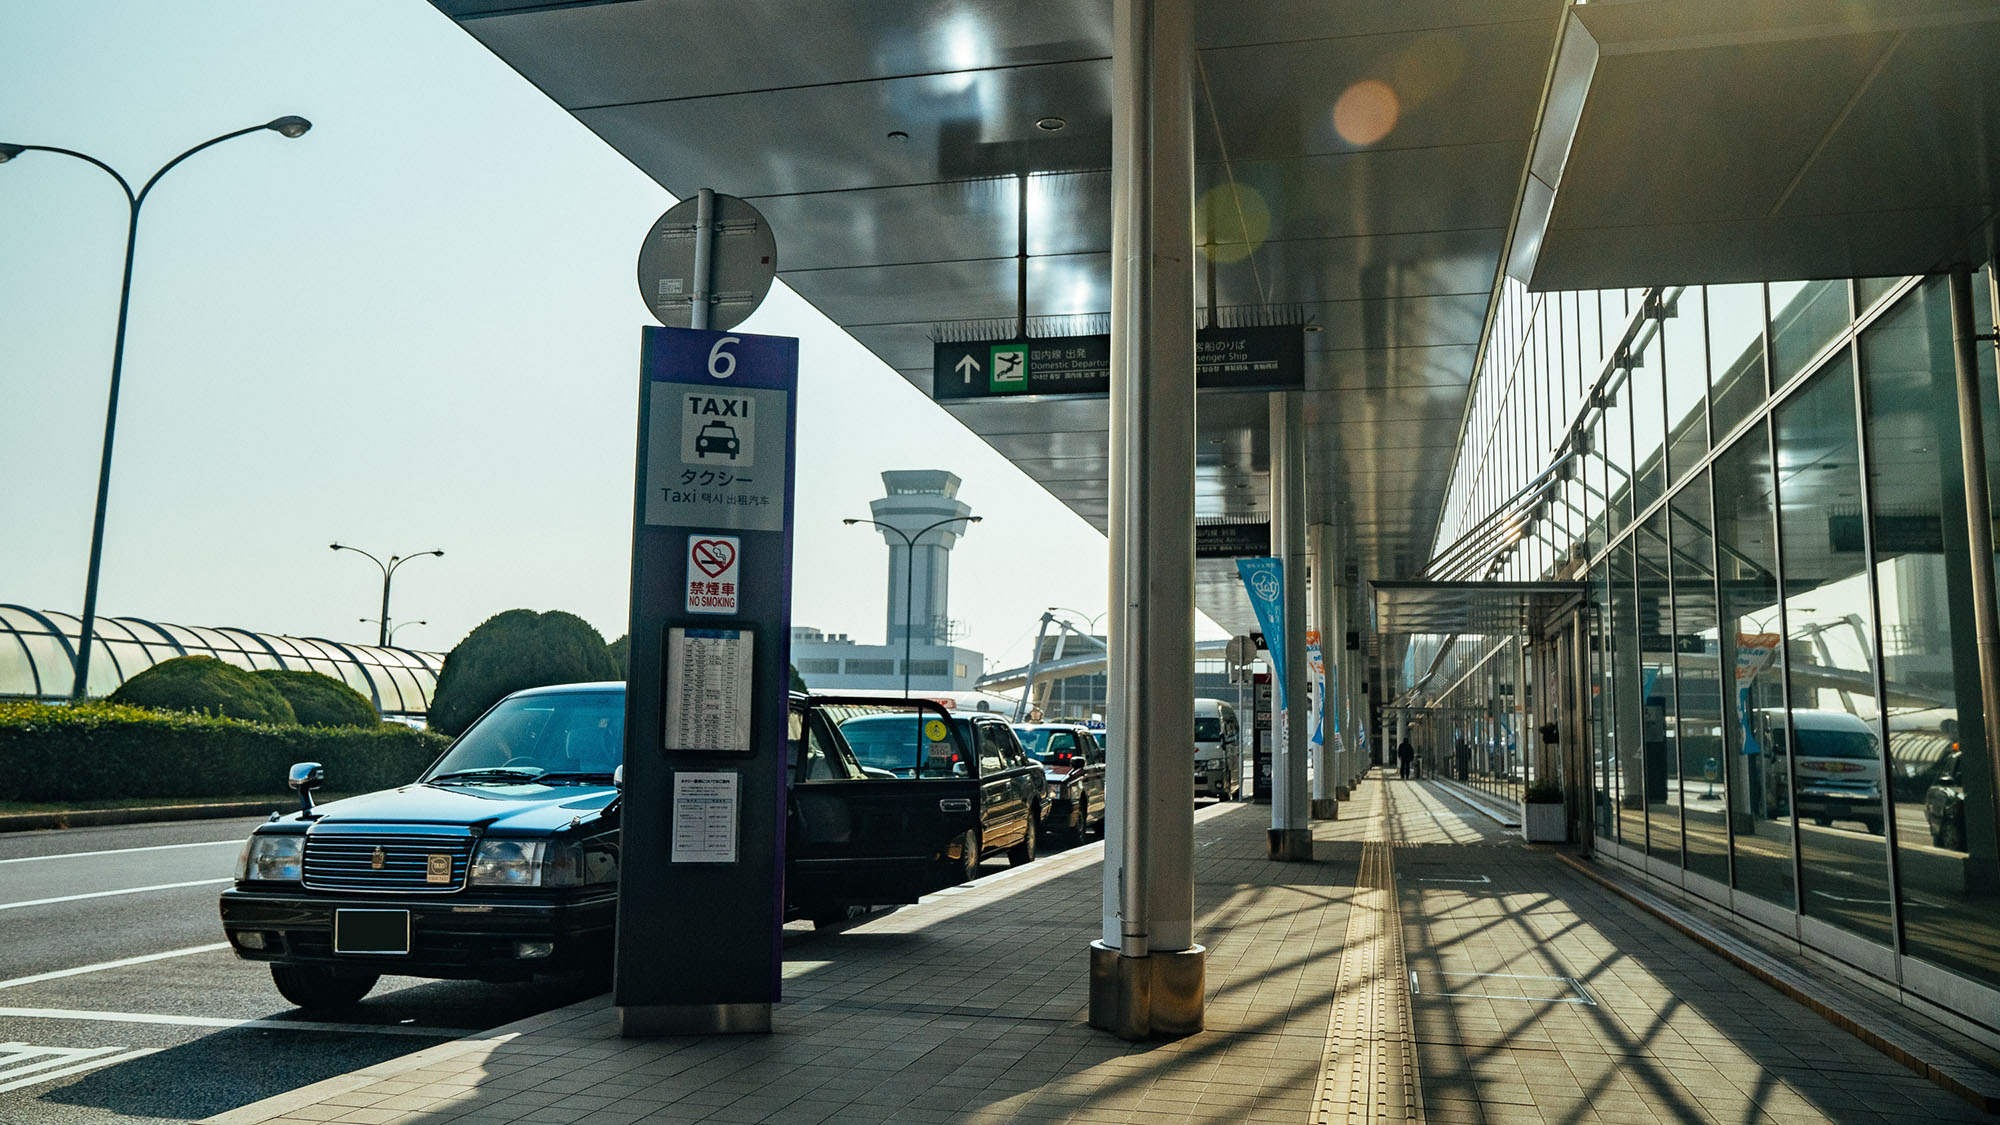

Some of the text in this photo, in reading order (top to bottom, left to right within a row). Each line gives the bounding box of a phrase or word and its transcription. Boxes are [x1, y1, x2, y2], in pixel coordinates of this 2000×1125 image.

[1196, 340, 1247, 352] 客船のりば
[708, 337, 740, 379] 6
[1065, 348, 1087, 359] 出発
[1196, 352, 1248, 363] senger Ship
[1031, 359, 1110, 370] Domestic Departur
[689, 397, 748, 418] TAXI
[681, 469, 753, 487] タクシー
[661, 488, 696, 503] Taxi
[701, 492, 723, 505] 택시
[690, 581, 735, 596] 禁煙車
[689, 596, 735, 608] NO SMOKING
